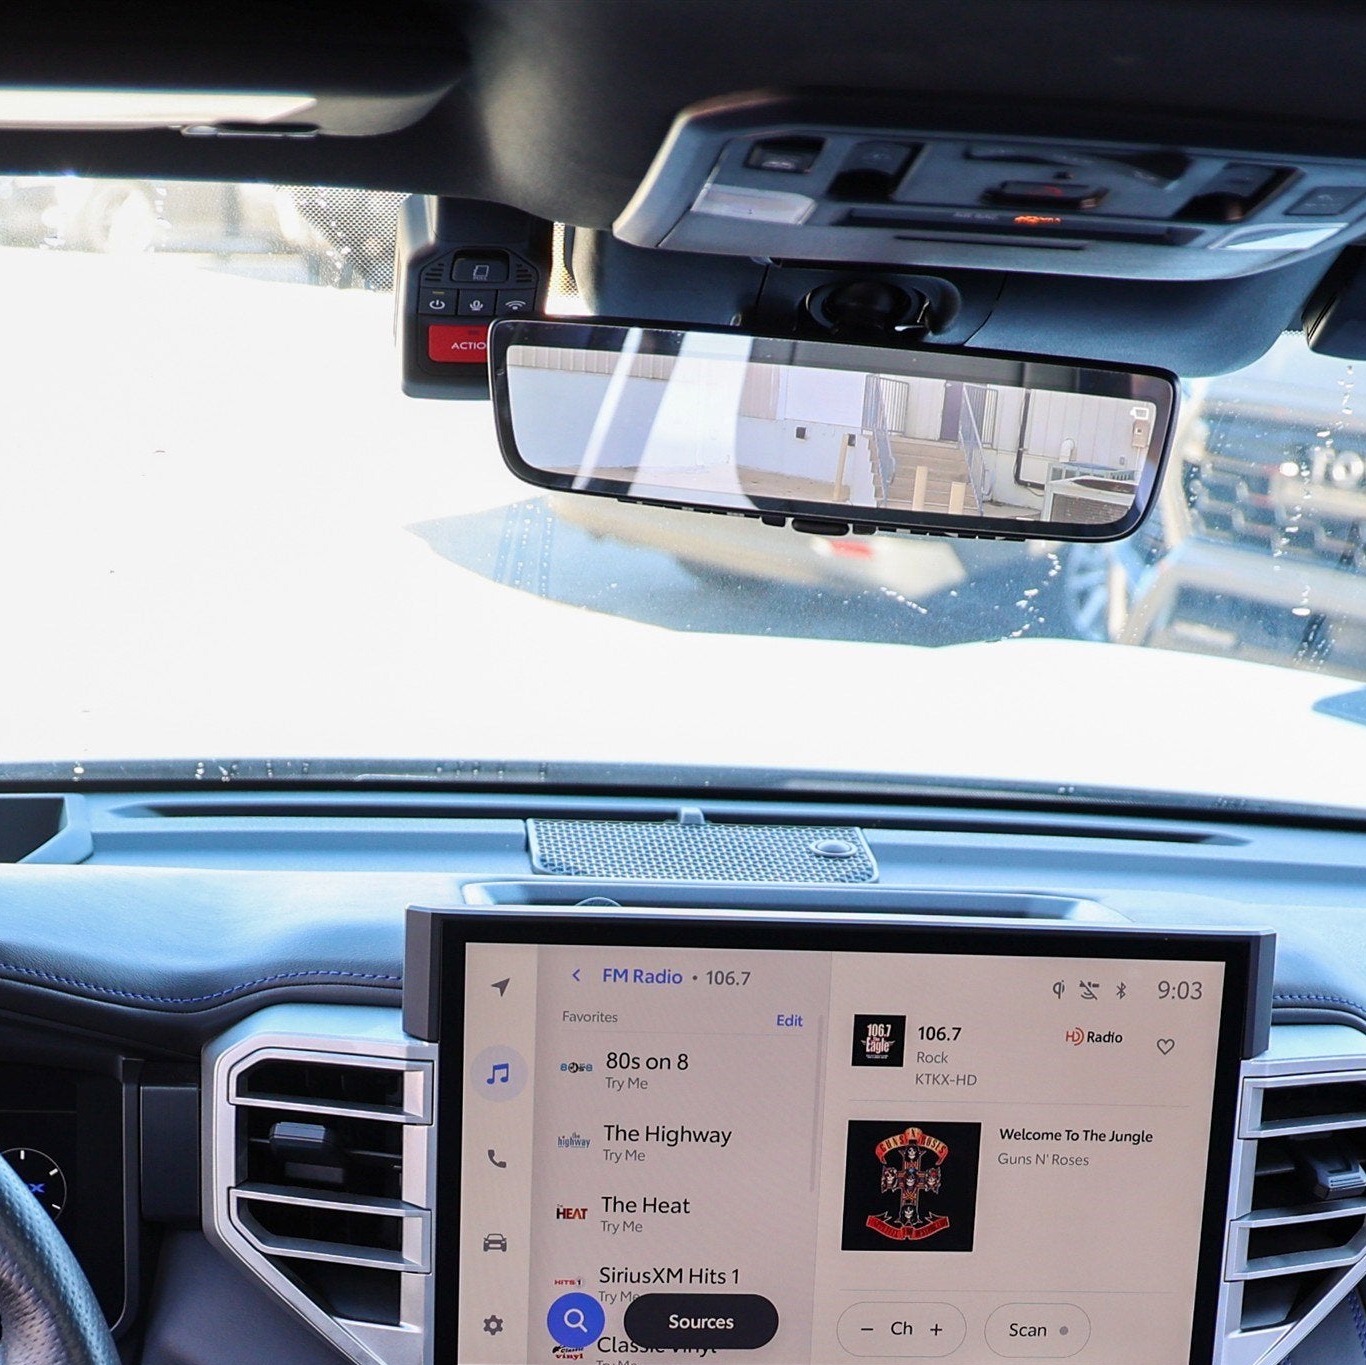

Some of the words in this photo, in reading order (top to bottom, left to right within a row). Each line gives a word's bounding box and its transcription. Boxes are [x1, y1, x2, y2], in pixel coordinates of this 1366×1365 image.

[602, 969, 629, 984] FM
[633, 968, 683, 985] Radio
[706, 970, 751, 986] 106.7
[1157, 981, 1203, 1000] 9:03
[562, 1010, 618, 1023] Favorites
[776, 1014, 803, 1027] Edit
[867, 1023, 892, 1037] 106.7
[918, 1026, 962, 1041] 106.7
[1087, 1031, 1123, 1044] Radio
[866, 1037, 890, 1054] Eagle
[606, 1052, 641, 1071] 80s
[645, 1057, 672, 1071] on
[677, 1053, 689, 1071] 8
[916, 1052, 949, 1064] Rock
[605, 1077, 628, 1092] Try
[630, 1077, 649, 1090] Me
[915, 1073, 978, 1086] KTKX-HD
[604, 1125, 640, 1143] The
[645, 1125, 732, 1148] Highway
[999, 1128, 1062, 1143] Welcome
[1065, 1129, 1080, 1143] To
[1082, 1129, 1107, 1143] The
[1109, 1130, 1154, 1146] Jungle
[603, 1149, 625, 1164] Try
[628, 1149, 646, 1162] Me
[997, 1153, 1032, 1167] Guns
[1051, 1153, 1090, 1167] Roses
[556, 1208, 588, 1219] HEAT
[602, 1197, 638, 1214] The
[643, 1197, 690, 1215] Heat
[600, 1220, 622, 1235] Try
[625, 1220, 643, 1233] Me
[599, 1266, 683, 1284] SiriusXM
[689, 1268, 726, 1284] Hits
[732, 1268, 739, 1284] 1
[598, 1290, 618, 1305] Try
[620, 1291, 639, 1303] Me
[668, 1314, 735, 1330] Sources
[890, 1321, 913, 1336] Ch
[1009, 1323, 1047, 1338] Scan
